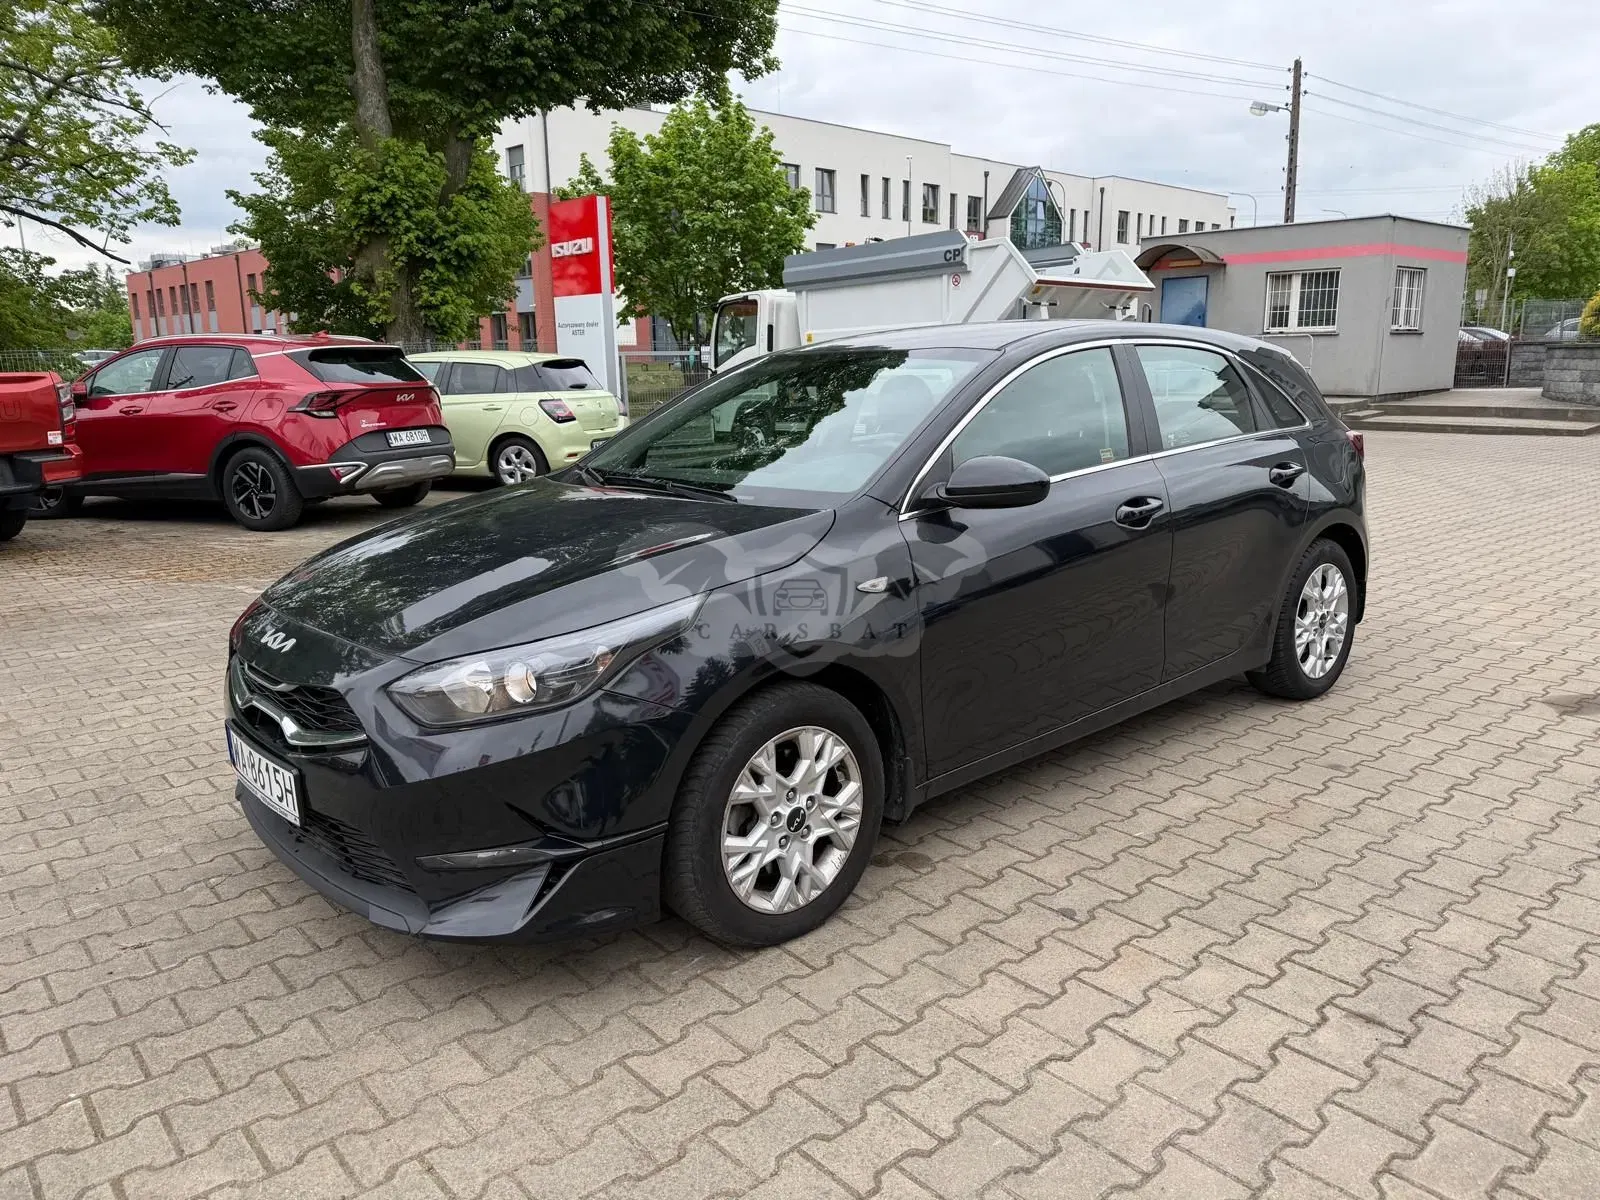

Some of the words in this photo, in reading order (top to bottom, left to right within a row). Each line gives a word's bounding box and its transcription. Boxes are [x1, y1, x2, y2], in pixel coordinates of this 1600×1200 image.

[551, 237, 593, 258] ISUZU
[943, 248, 961, 262] CP
[396, 393, 415, 402] KIA
[391, 432, 404, 444] WA
[260, 628, 297, 653] KIA
[231, 733, 248, 777] WA
[248, 749, 296, 812] 8615H
